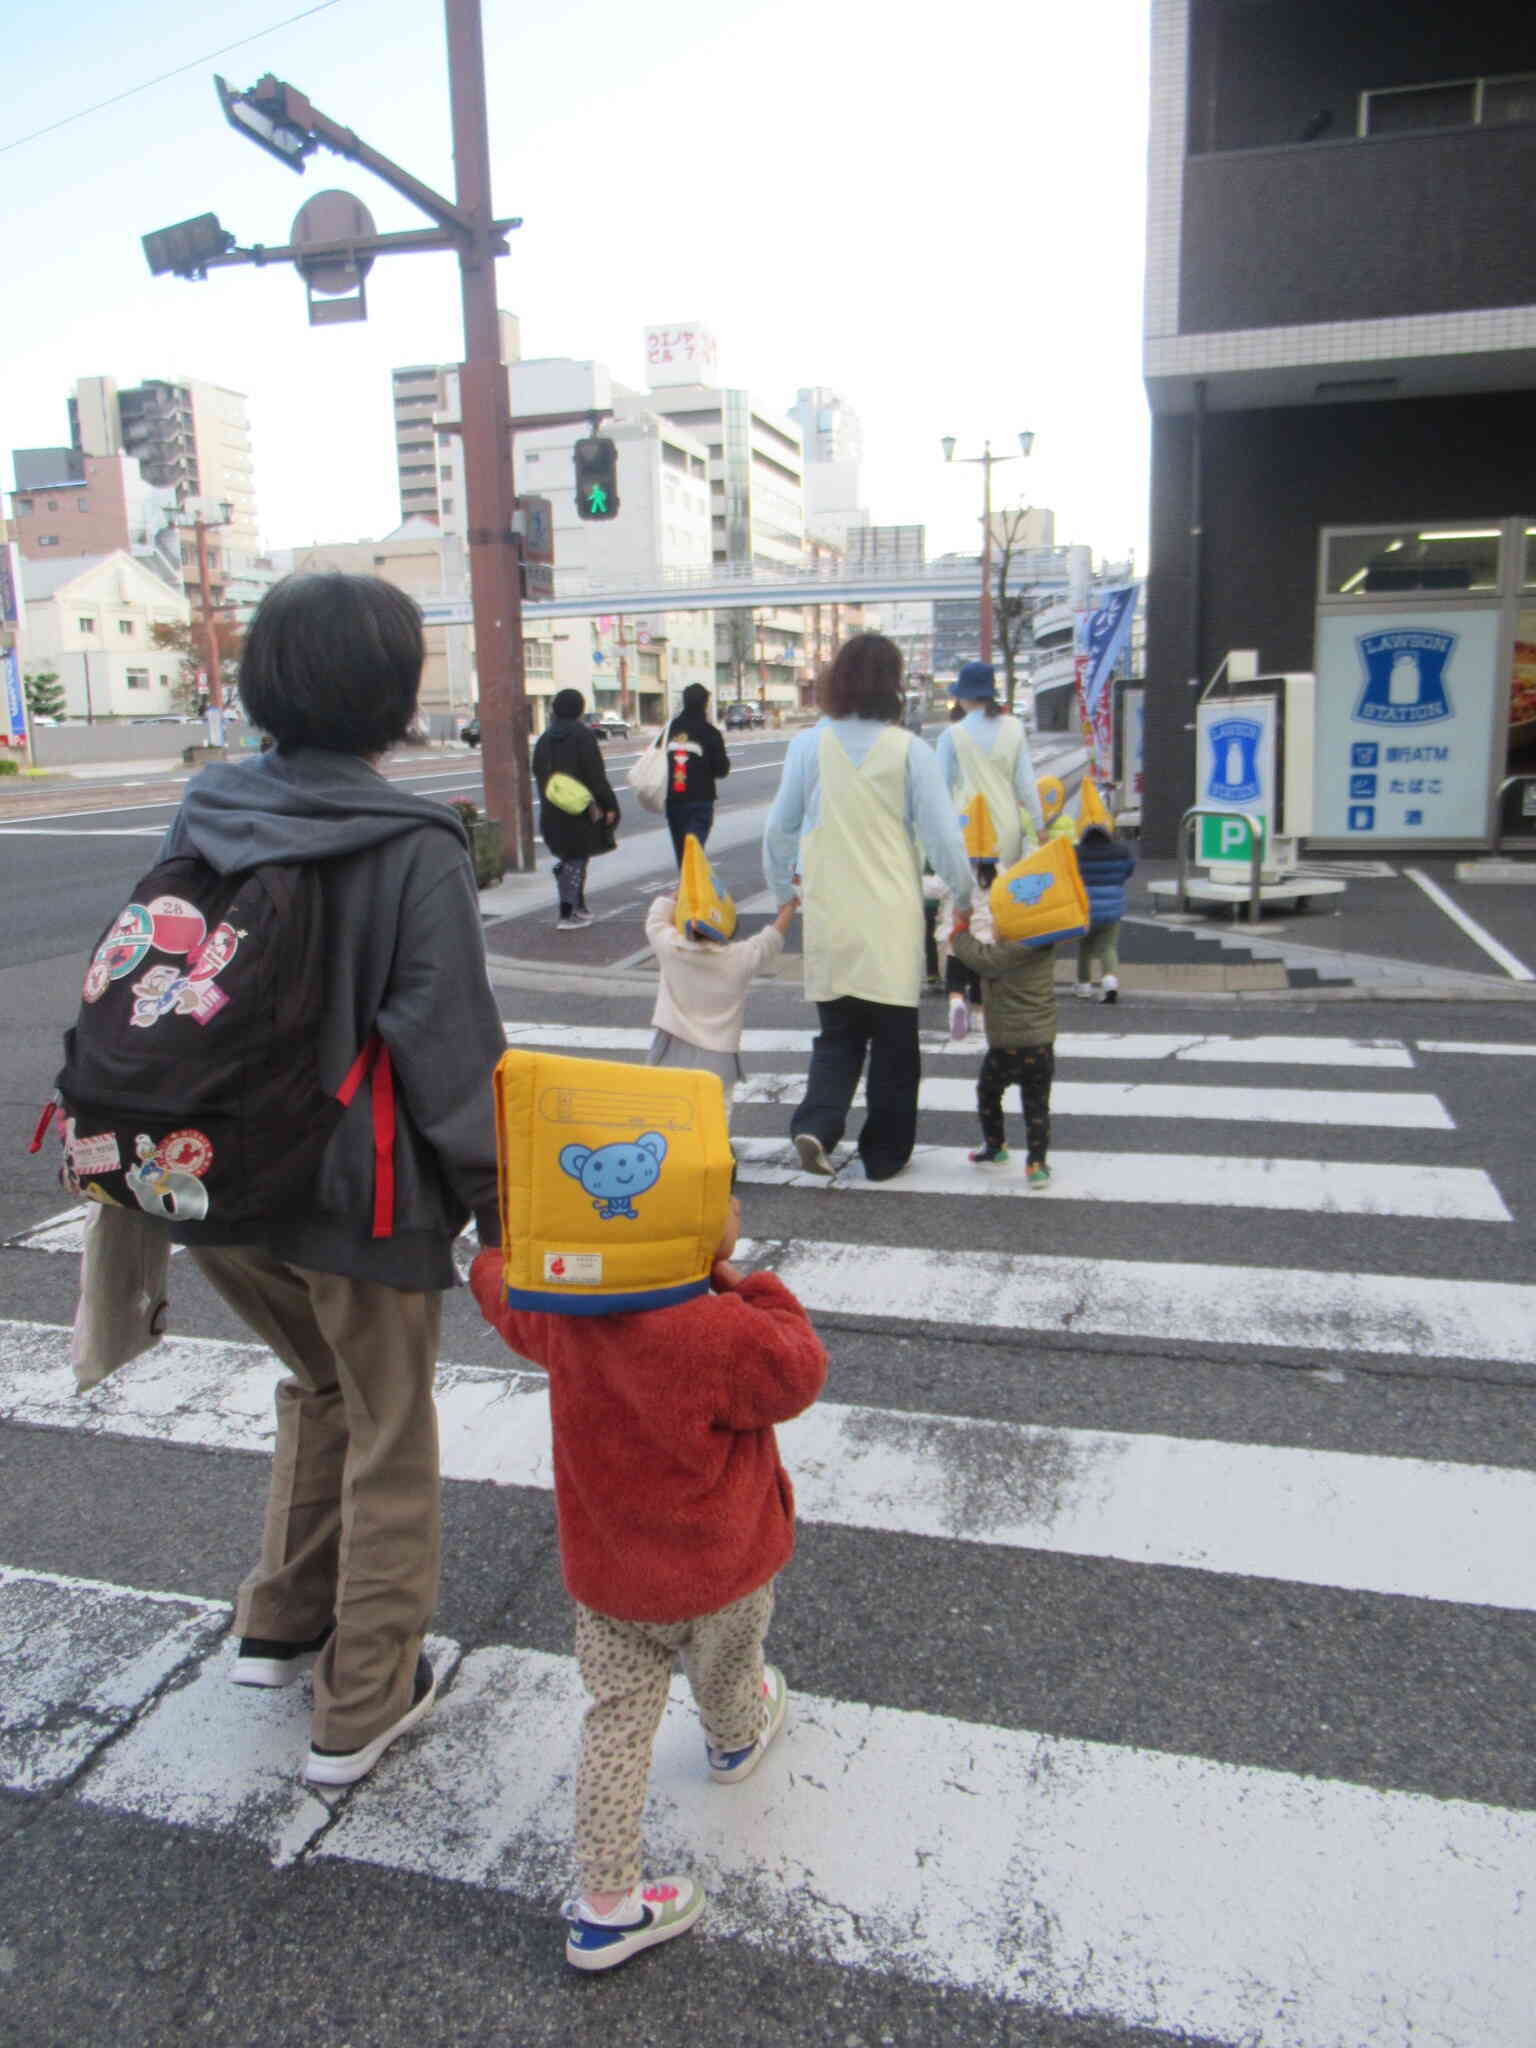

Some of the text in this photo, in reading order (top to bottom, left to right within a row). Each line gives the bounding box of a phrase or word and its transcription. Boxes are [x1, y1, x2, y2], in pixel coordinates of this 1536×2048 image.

[1363, 634, 1450, 655] LAWSON
[1361, 702, 1446, 721] STATION
[1388, 778, 1443, 795] たばこ
[1220, 820, 1247, 854] P
